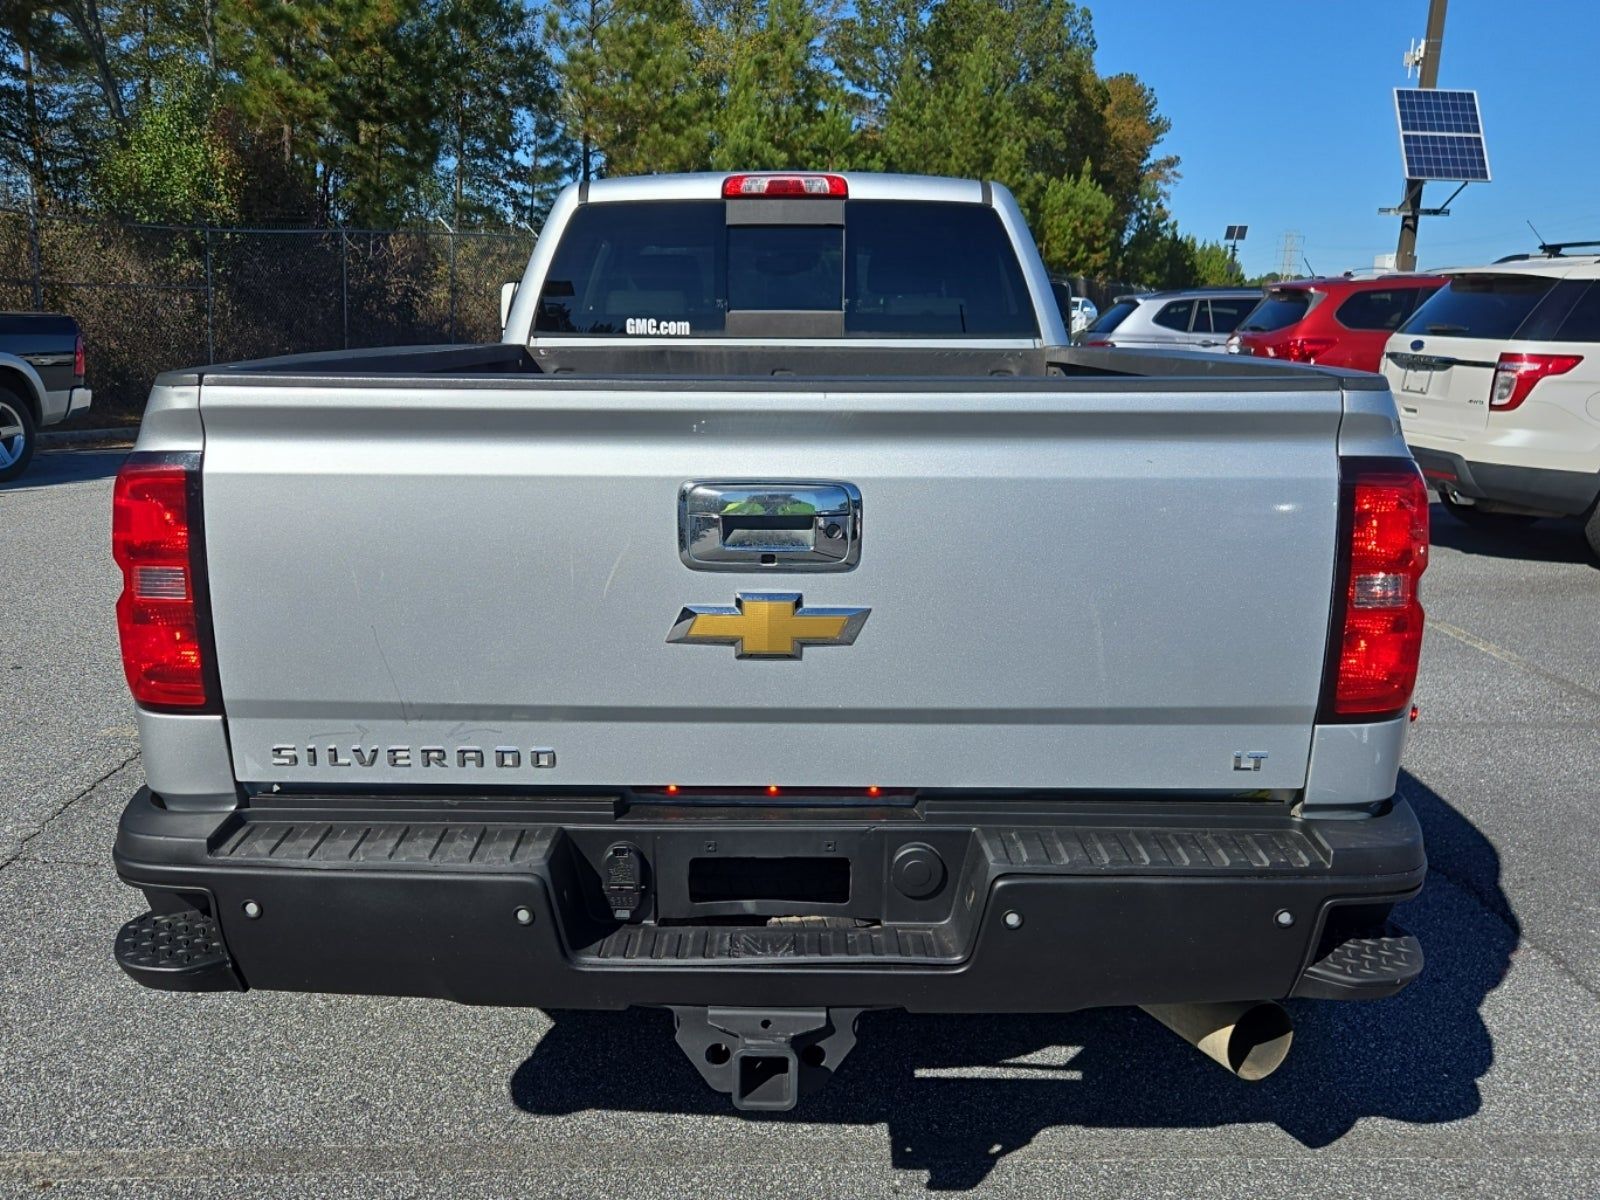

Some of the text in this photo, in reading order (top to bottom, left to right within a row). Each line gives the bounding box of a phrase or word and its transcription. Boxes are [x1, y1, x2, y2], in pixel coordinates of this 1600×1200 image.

[626, 317, 690, 335] GMC.com
[272, 744, 557, 768] SILVERADO
[1233, 750, 1269, 771] LT
